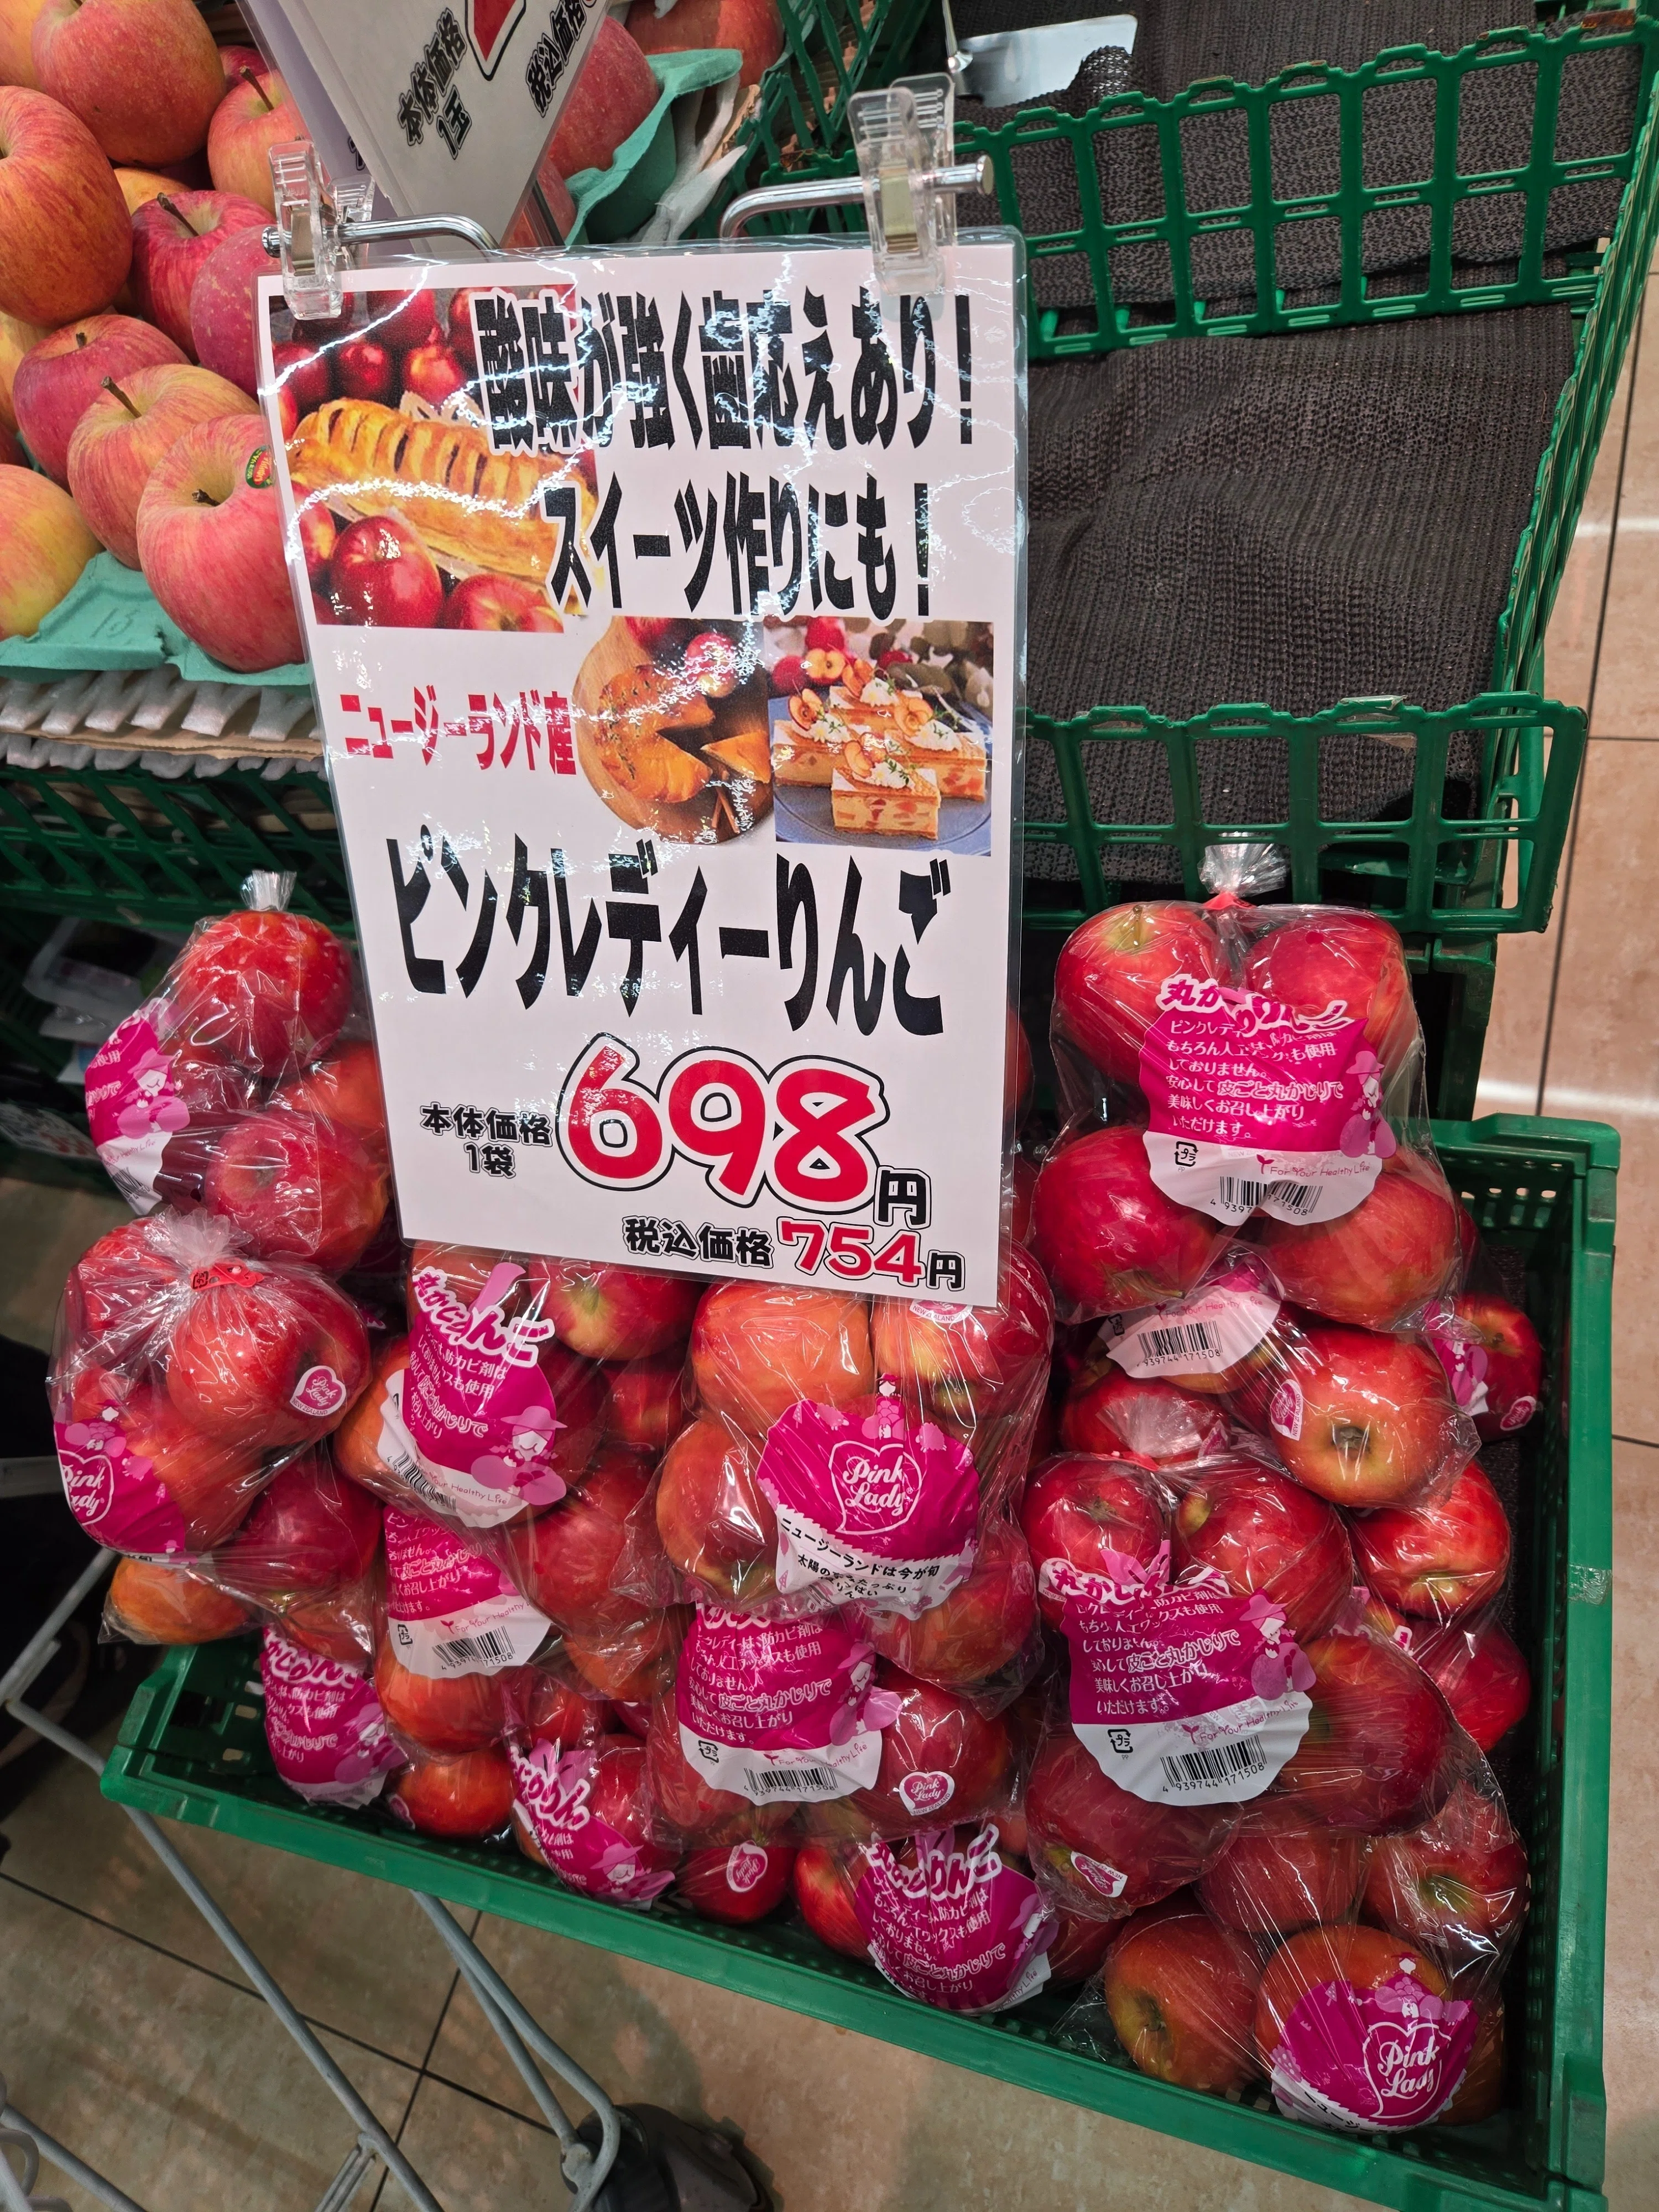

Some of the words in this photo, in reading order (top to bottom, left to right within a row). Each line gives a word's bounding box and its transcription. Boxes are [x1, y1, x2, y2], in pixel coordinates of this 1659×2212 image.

[398, 8, 467, 145] 本体価格
[437, 85, 472, 159] 1玉
[340, 685, 577, 775] ニュージーランド産
[386, 824, 952, 1037] ピンクレディーりんご
[1169, 1058, 1267, 1077] しておりません。
[420, 1102, 552, 1147] 本体価格
[1172, 1115, 1251, 1138] いただけます。
[463, 1144, 517, 1178] 1袋
[1270, 1166, 1290, 1175] For
[1292, 1167, 1317, 1177] Your
[1319, 1166, 1353, 1176] Healthy
[1353, 1160, 1370, 1174] Life
[622, 1215, 775, 1269] 税込価格
[912, 1305, 926, 1316] NEW
[1165, 1309, 1181, 1318] For
[306, 1385, 329, 1406] Lady
[312, 1376, 338, 1399] Pink
[302, 1405, 328, 1416] ZEALAND
[842, 1454, 904, 1485] Pink
[451, 1483, 486, 1500] Healthy
[487, 1494, 507, 1505] Life
[780, 1517, 940, 1580] ニュージーランドは今が旬
[455, 1625, 469, 1633] For
[492, 1603, 525, 1620] Healthy
[1199, 1731, 1217, 1742] For
[1246, 1708, 1281, 1728] Healthy
[852, 1743, 868, 1758] Life
[910, 1778, 940, 1793] Pink
[1176, 1778, 1218, 1792] 939744
[1224, 1761, 1265, 1786] 171508
[914, 1788, 941, 1802] Lady
[928, 1793, 951, 1810] ZEALAND
[1378, 2034, 1440, 2077] Pink
